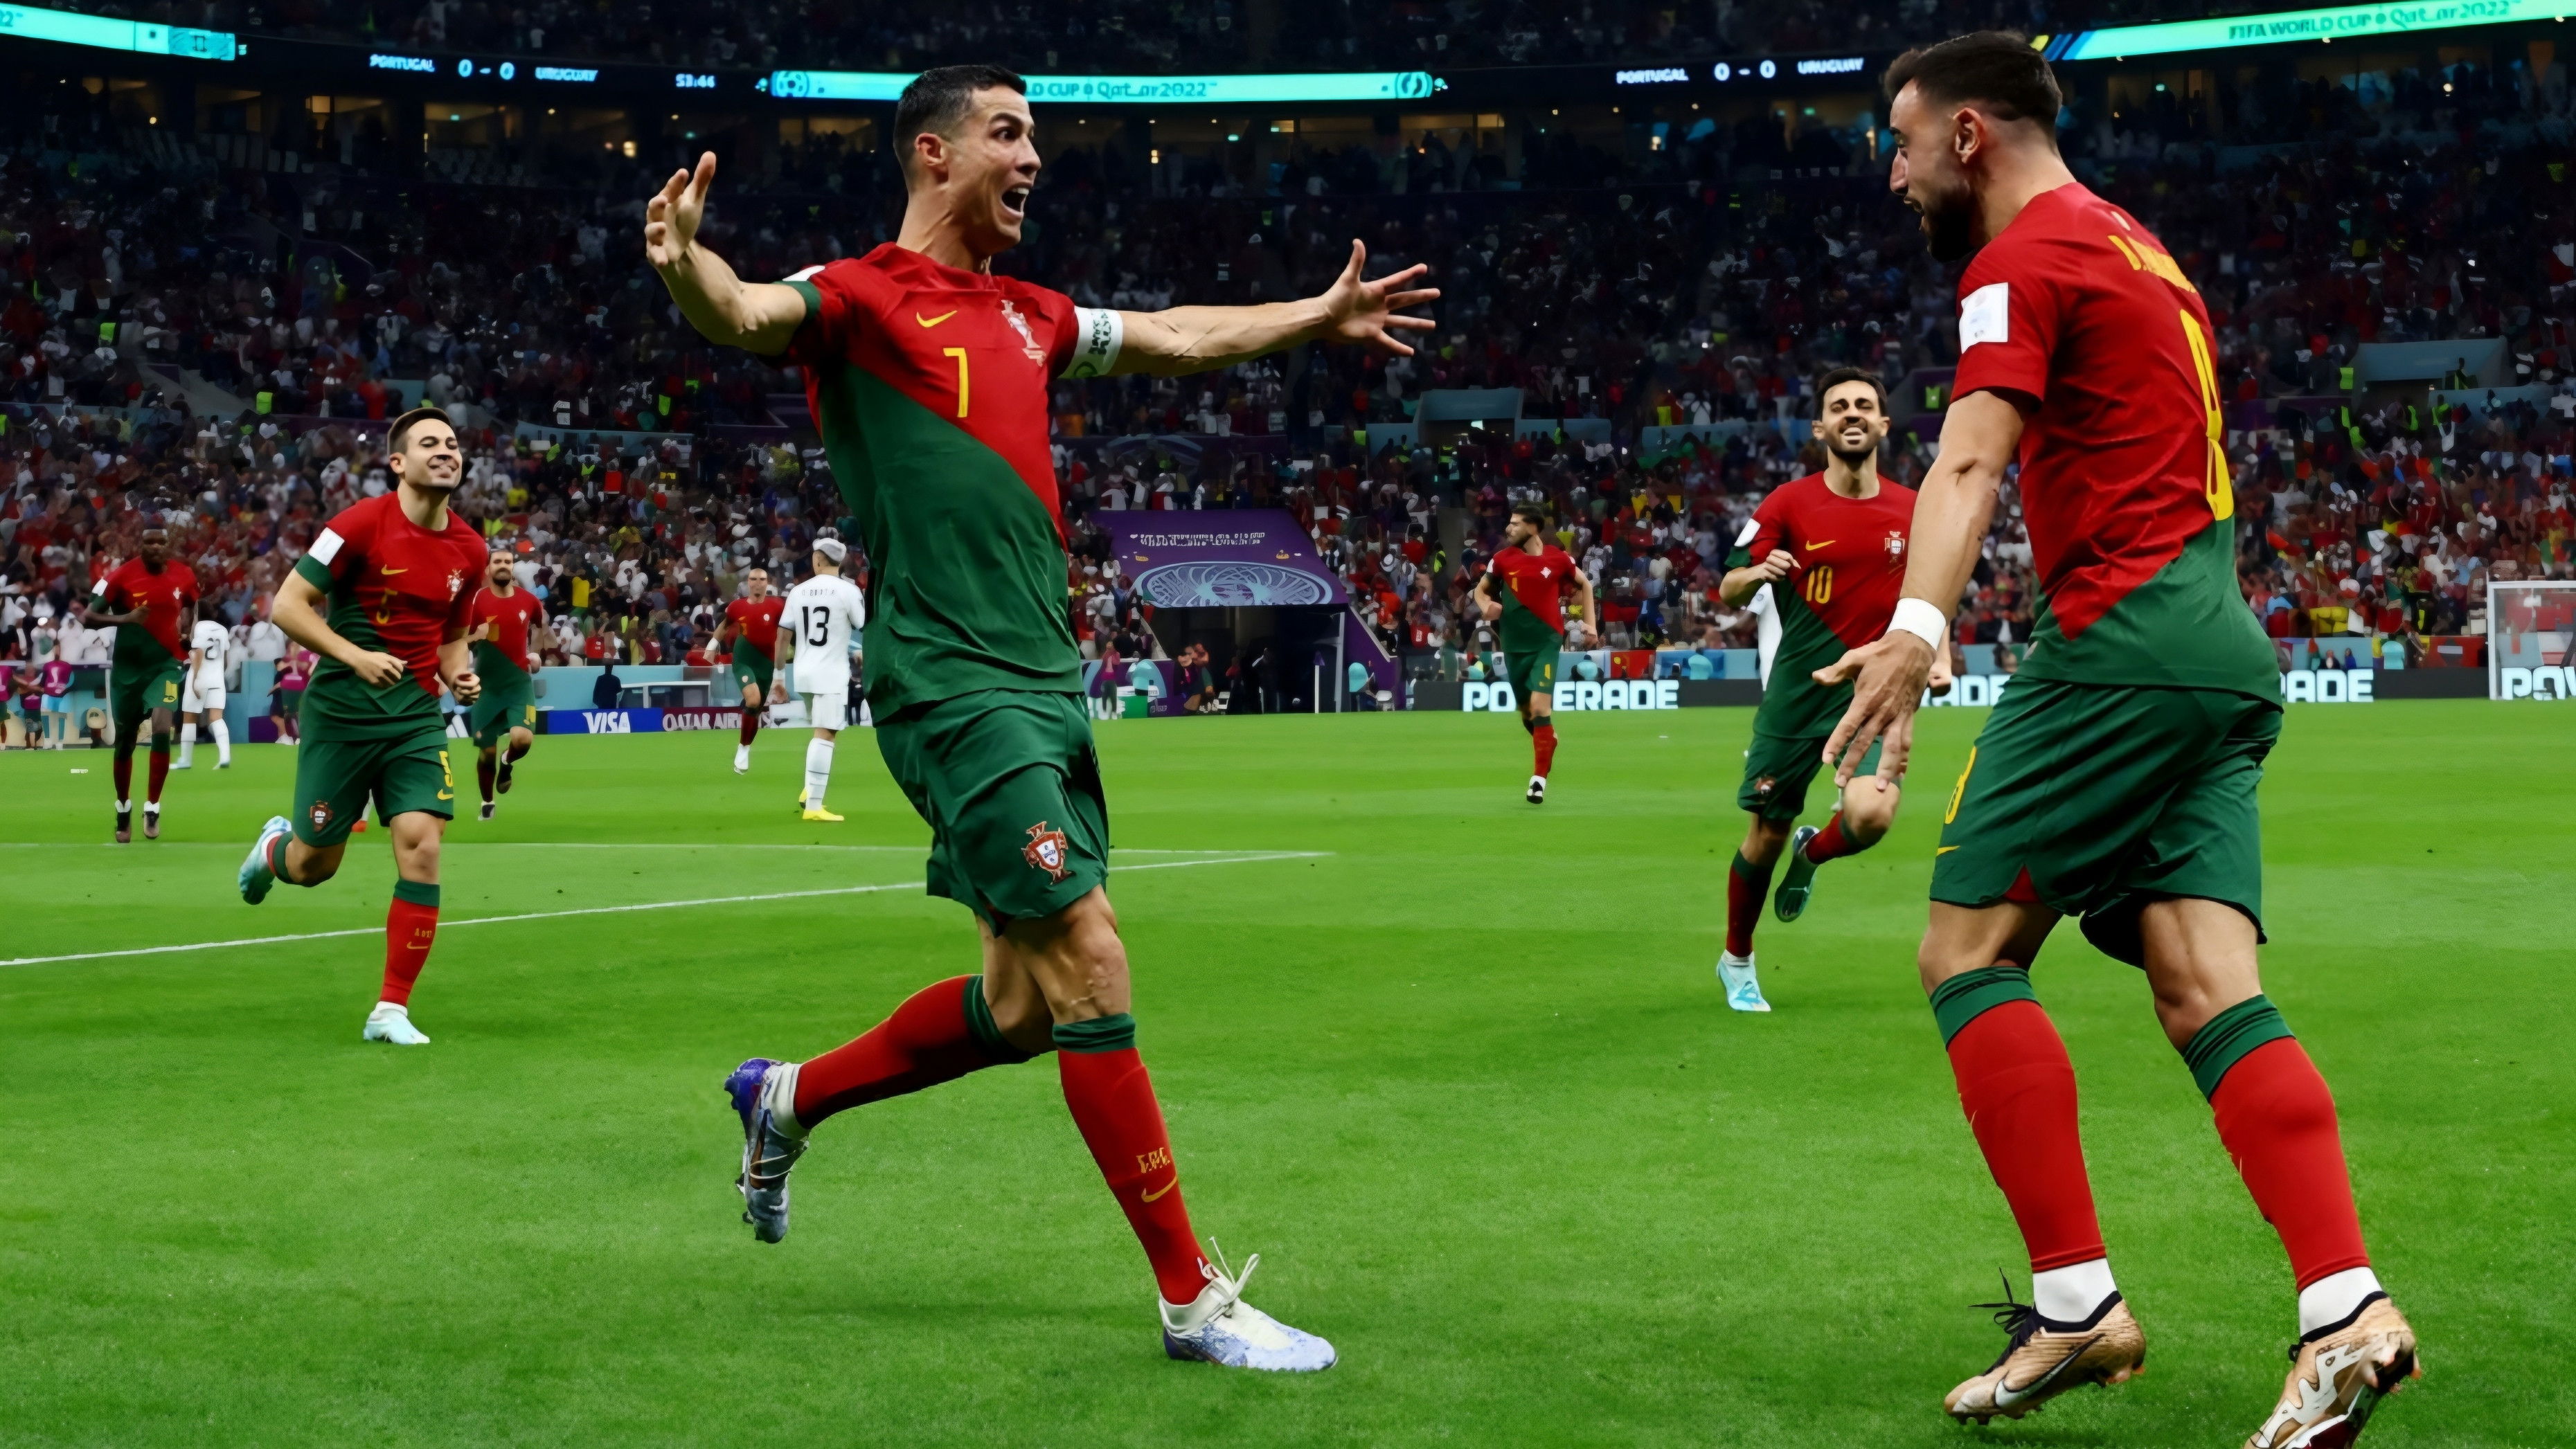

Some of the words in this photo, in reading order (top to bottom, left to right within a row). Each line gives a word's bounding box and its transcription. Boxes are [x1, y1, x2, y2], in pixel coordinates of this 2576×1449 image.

[2229, 24, 2266, 39] FIFA
[2269, 17, 2334, 35] WORLD
[2337, 14, 2372, 30] CUP
[370, 54, 435, 72] PORTUGAL
[458, 60, 472, 77] 0
[499, 62, 515, 80] 0
[1617, 69, 1688, 84] PORTUGAL
[1715, 62, 1730, 81] 0
[1760, 60, 1776, 78] 0
[1798, 58, 1863, 74] URUGUAY
[1048, 82, 1080, 97] CUP
[943, 348, 969, 418] 7
[2180, 308, 2235, 521] 8
[1806, 565, 1833, 604] 10
[802, 606, 830, 647] 13
[1463, 680, 1679, 712] POERADE
[2280, 669, 2374, 703] ADE
[582, 712, 631, 734] VISA
[663, 713, 711, 732] QATAR
